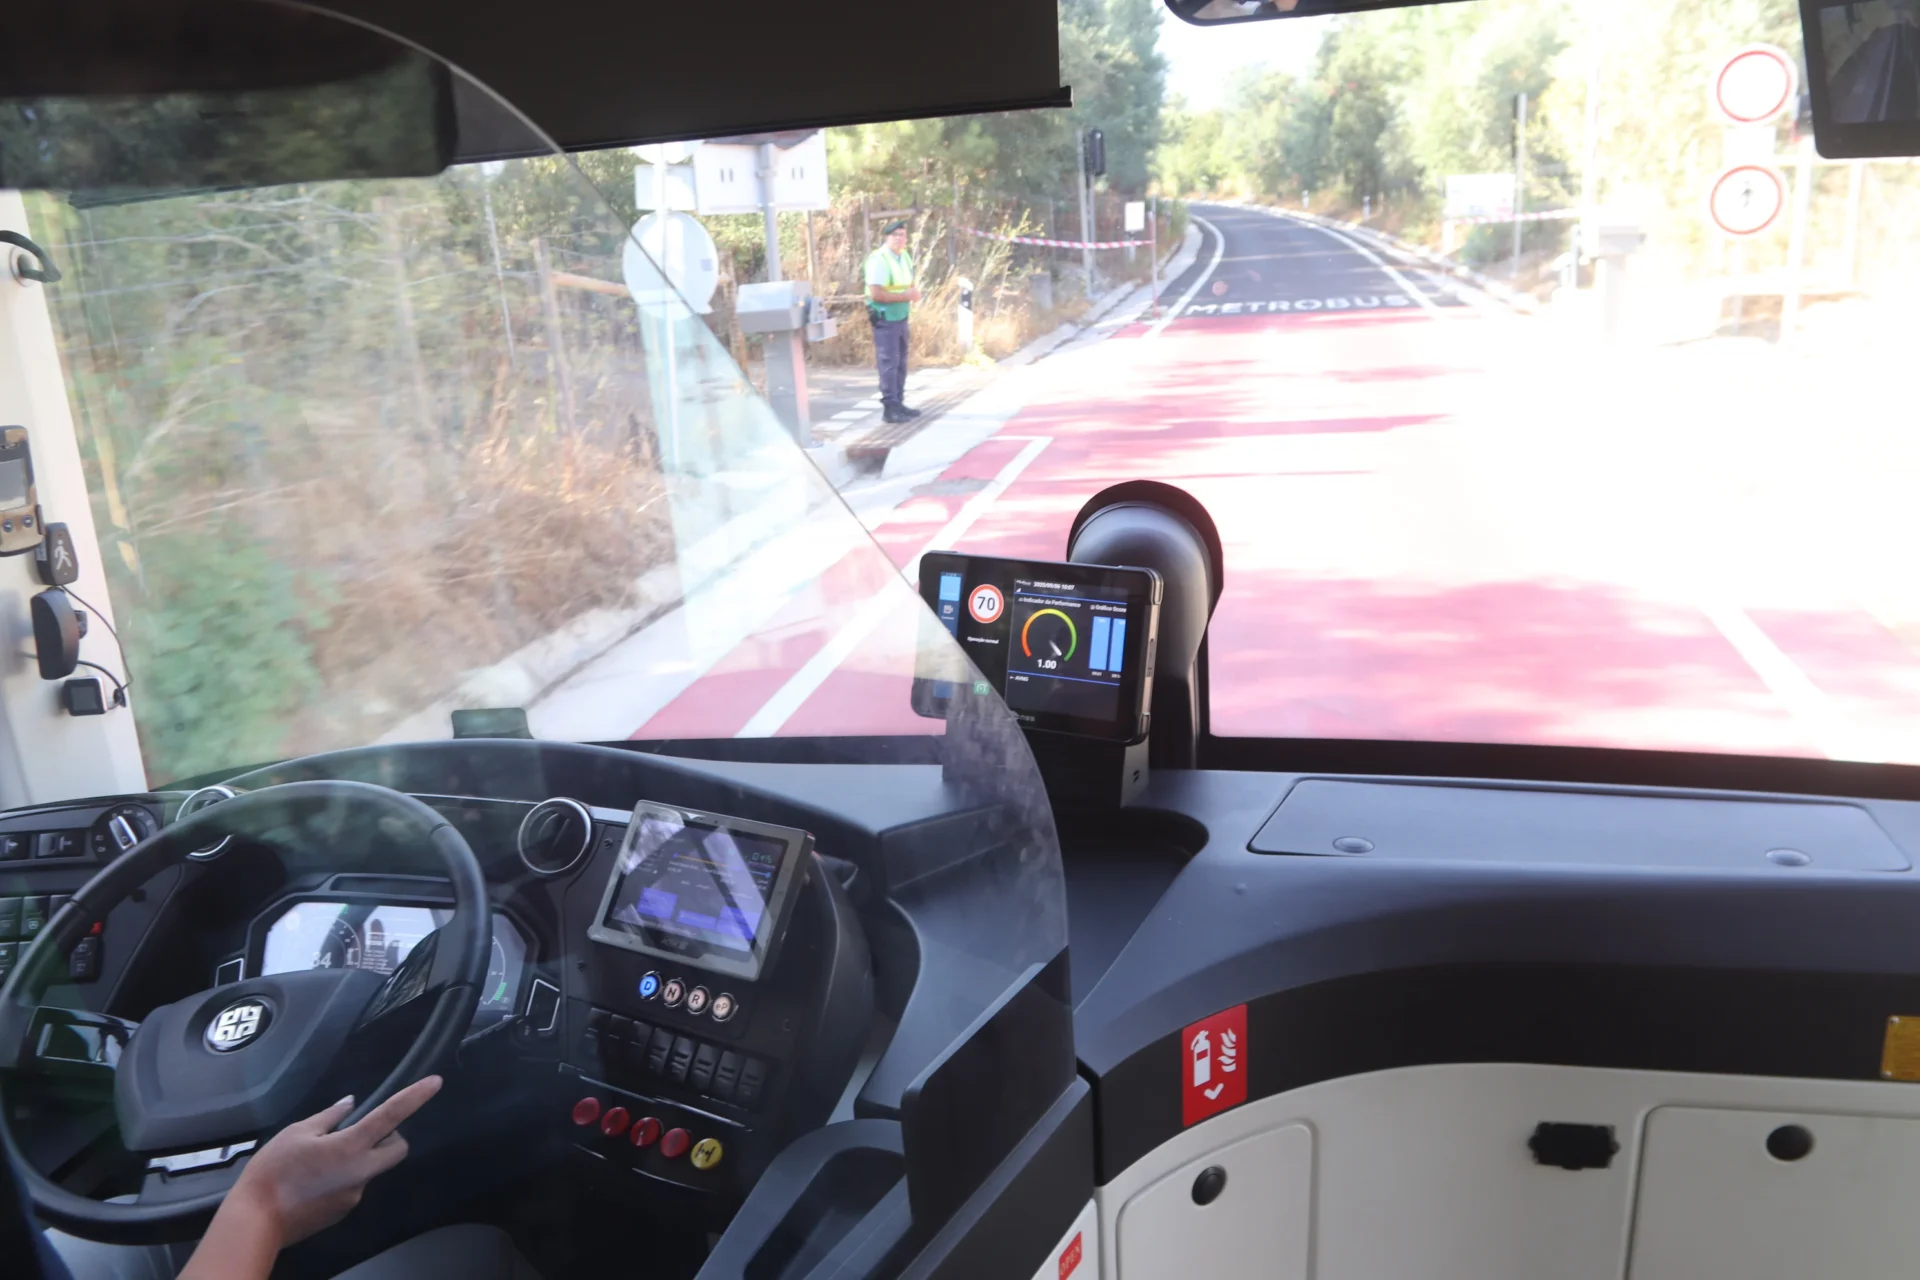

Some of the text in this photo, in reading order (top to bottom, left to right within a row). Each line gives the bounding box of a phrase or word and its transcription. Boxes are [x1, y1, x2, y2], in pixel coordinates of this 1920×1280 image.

[1187, 294, 1410, 315] METROBUS
[977, 596, 996, 611] 70
[1052, 600, 1081, 608] Performance
[1037, 659, 1057, 669] 1.00
[643, 981, 651, 991] D
[668, 988, 677, 999] N
[691, 994, 700, 1005] R
